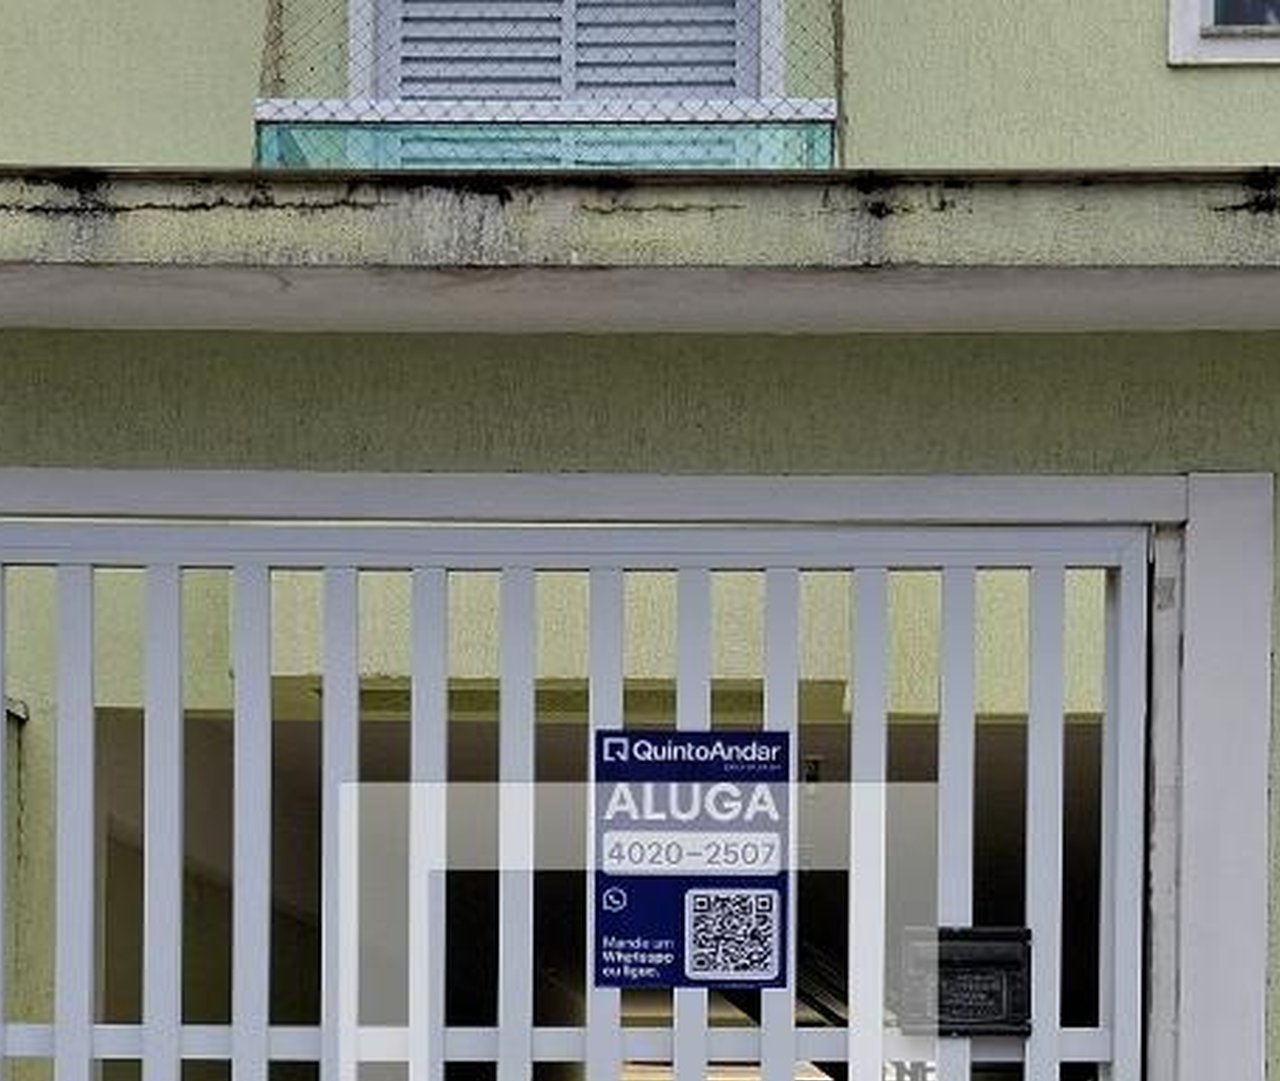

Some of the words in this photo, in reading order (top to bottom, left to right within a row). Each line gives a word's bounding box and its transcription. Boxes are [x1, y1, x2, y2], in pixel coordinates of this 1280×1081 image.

[632, 739, 782, 761] QuintoAndar
[603, 782, 780, 821] ALUGA
[607, 841, 776, 865] 4020-2507
